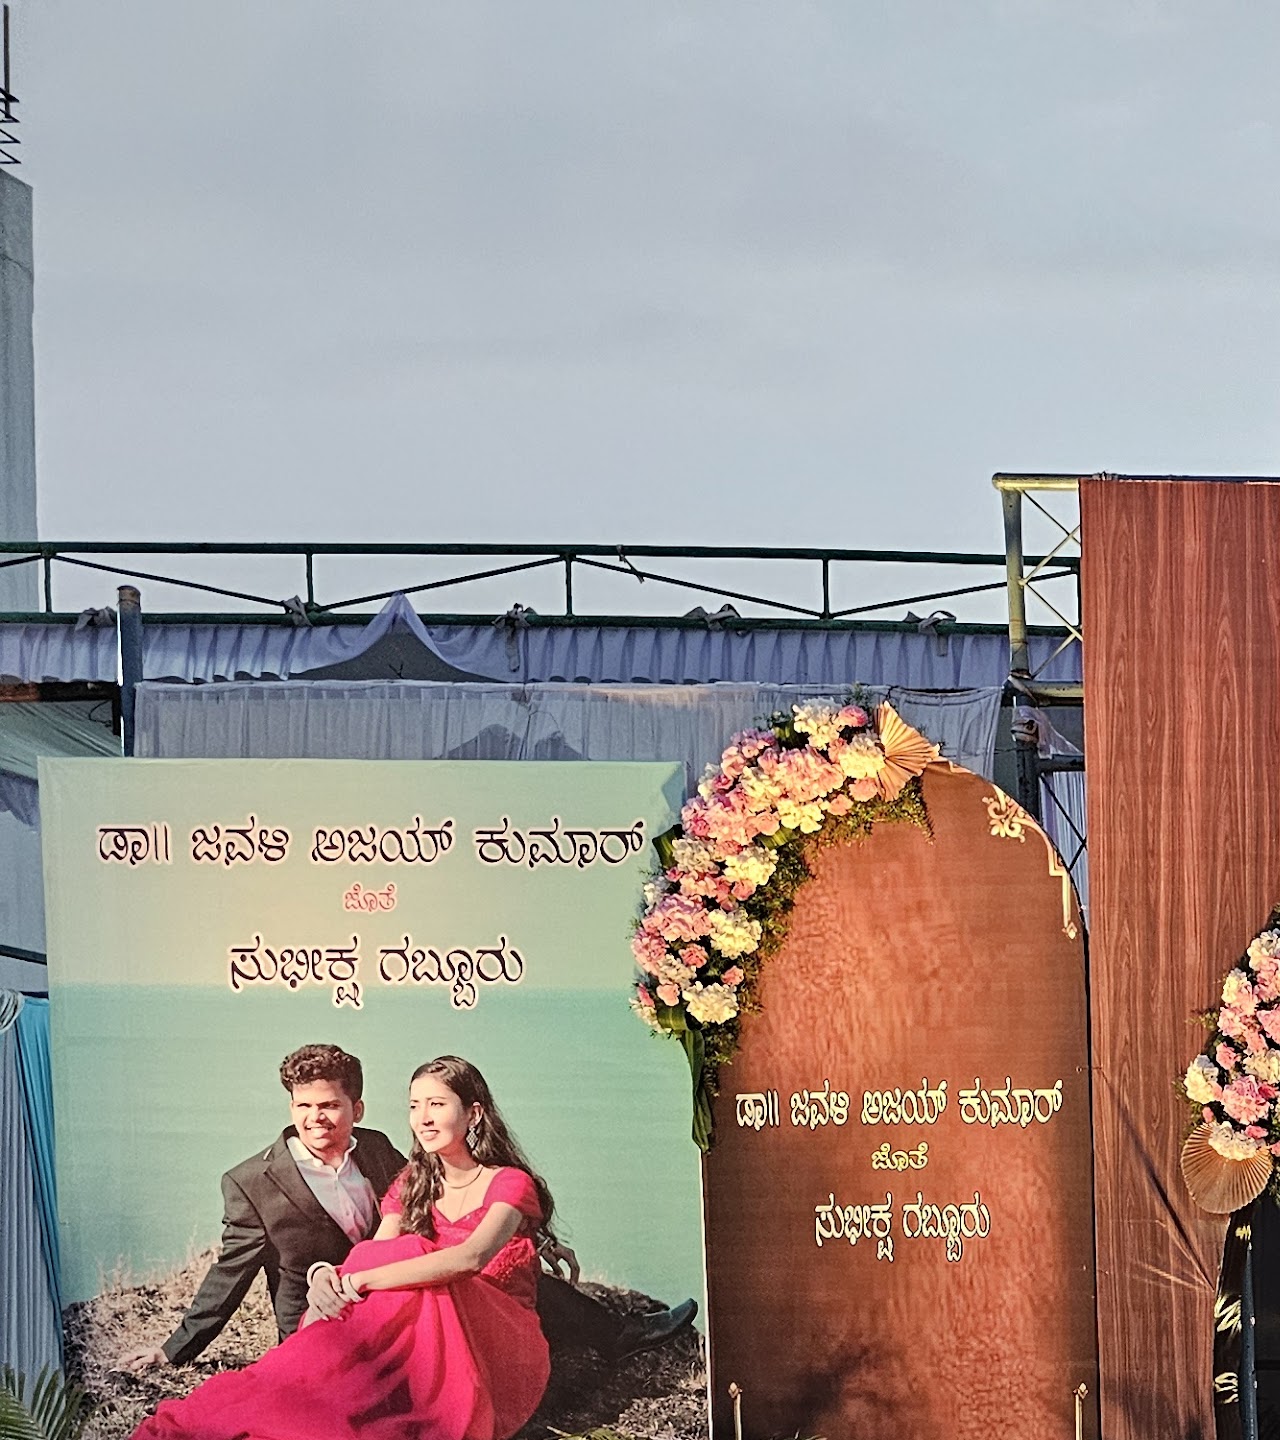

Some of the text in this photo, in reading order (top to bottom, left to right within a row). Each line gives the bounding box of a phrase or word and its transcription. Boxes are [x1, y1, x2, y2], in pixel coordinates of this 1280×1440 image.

[192, 816, 289, 866] ಜವಳಿ
[312, 817, 452, 862] ಅಜಯ್
[475, 817, 644, 868] ಕುಮಾರ್
[344, 883, 396, 912] ಜೊತೆ
[231, 936, 523, 1007] ಸುಭೀಕ್ಷ ಗಬ್ಬೂರು
[790, 1079, 849, 1130] ಜವಳಿ
[861, 1077, 948, 1125] ಅಜಯ್
[958, 1076, 1064, 1128] ಕುಮಾರ್
[871, 1142, 930, 1171] ಜೊತೆ
[901, 1191, 991, 1262] ಗಬ್ಬೂರು
